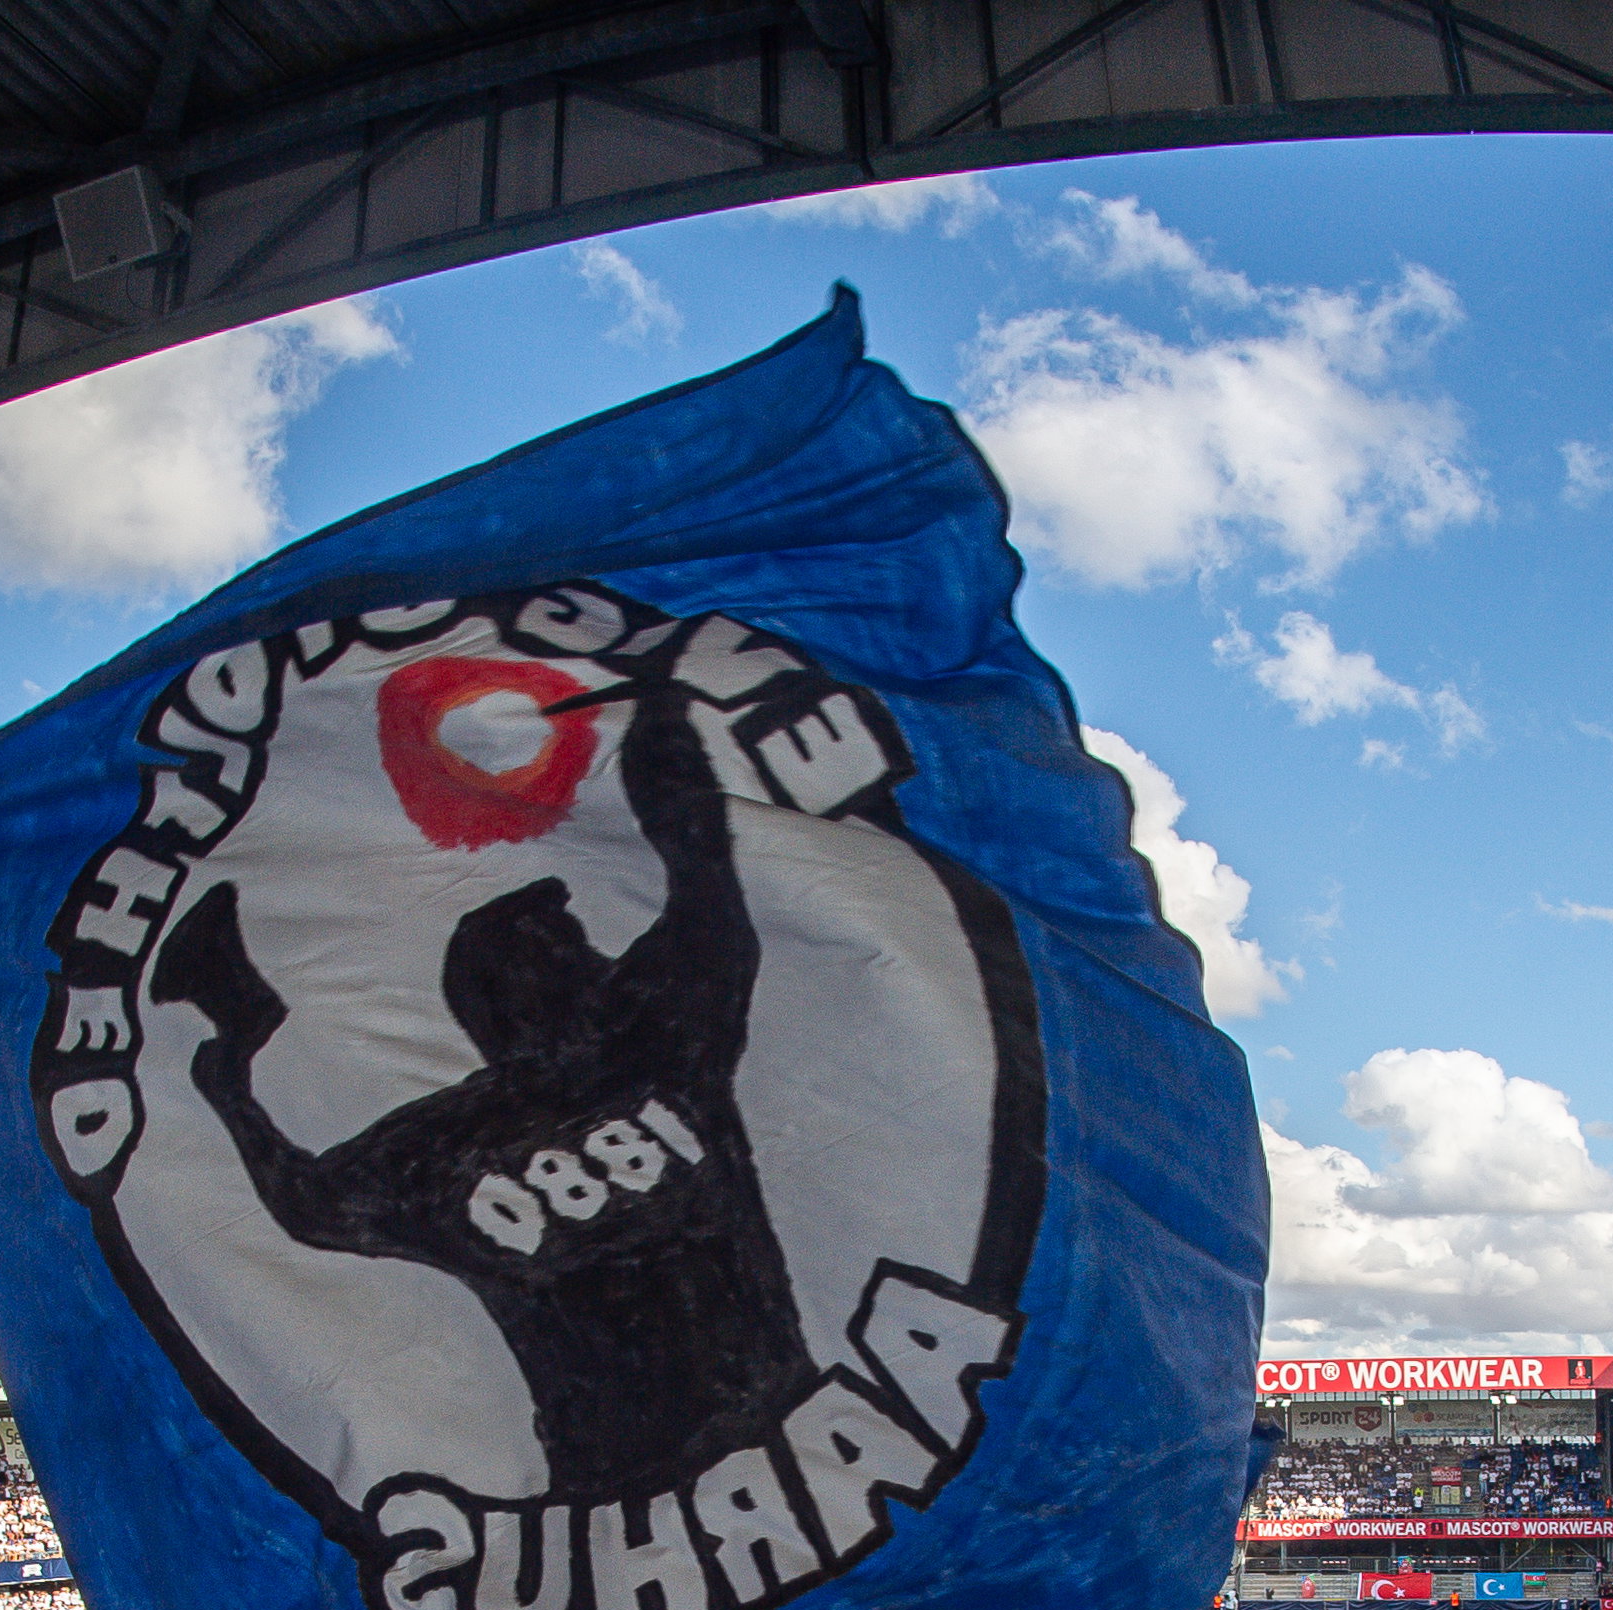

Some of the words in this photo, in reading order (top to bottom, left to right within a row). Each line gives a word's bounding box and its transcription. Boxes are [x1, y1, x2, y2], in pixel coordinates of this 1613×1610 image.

[1347, 1357, 1545, 1390] WORKWEAR
[1299, 1410, 1353, 1426] SPORT
[1334, 1520, 1427, 1536] WORKWEAR
[1522, 1520, 1613, 1536] WORKWEAR
